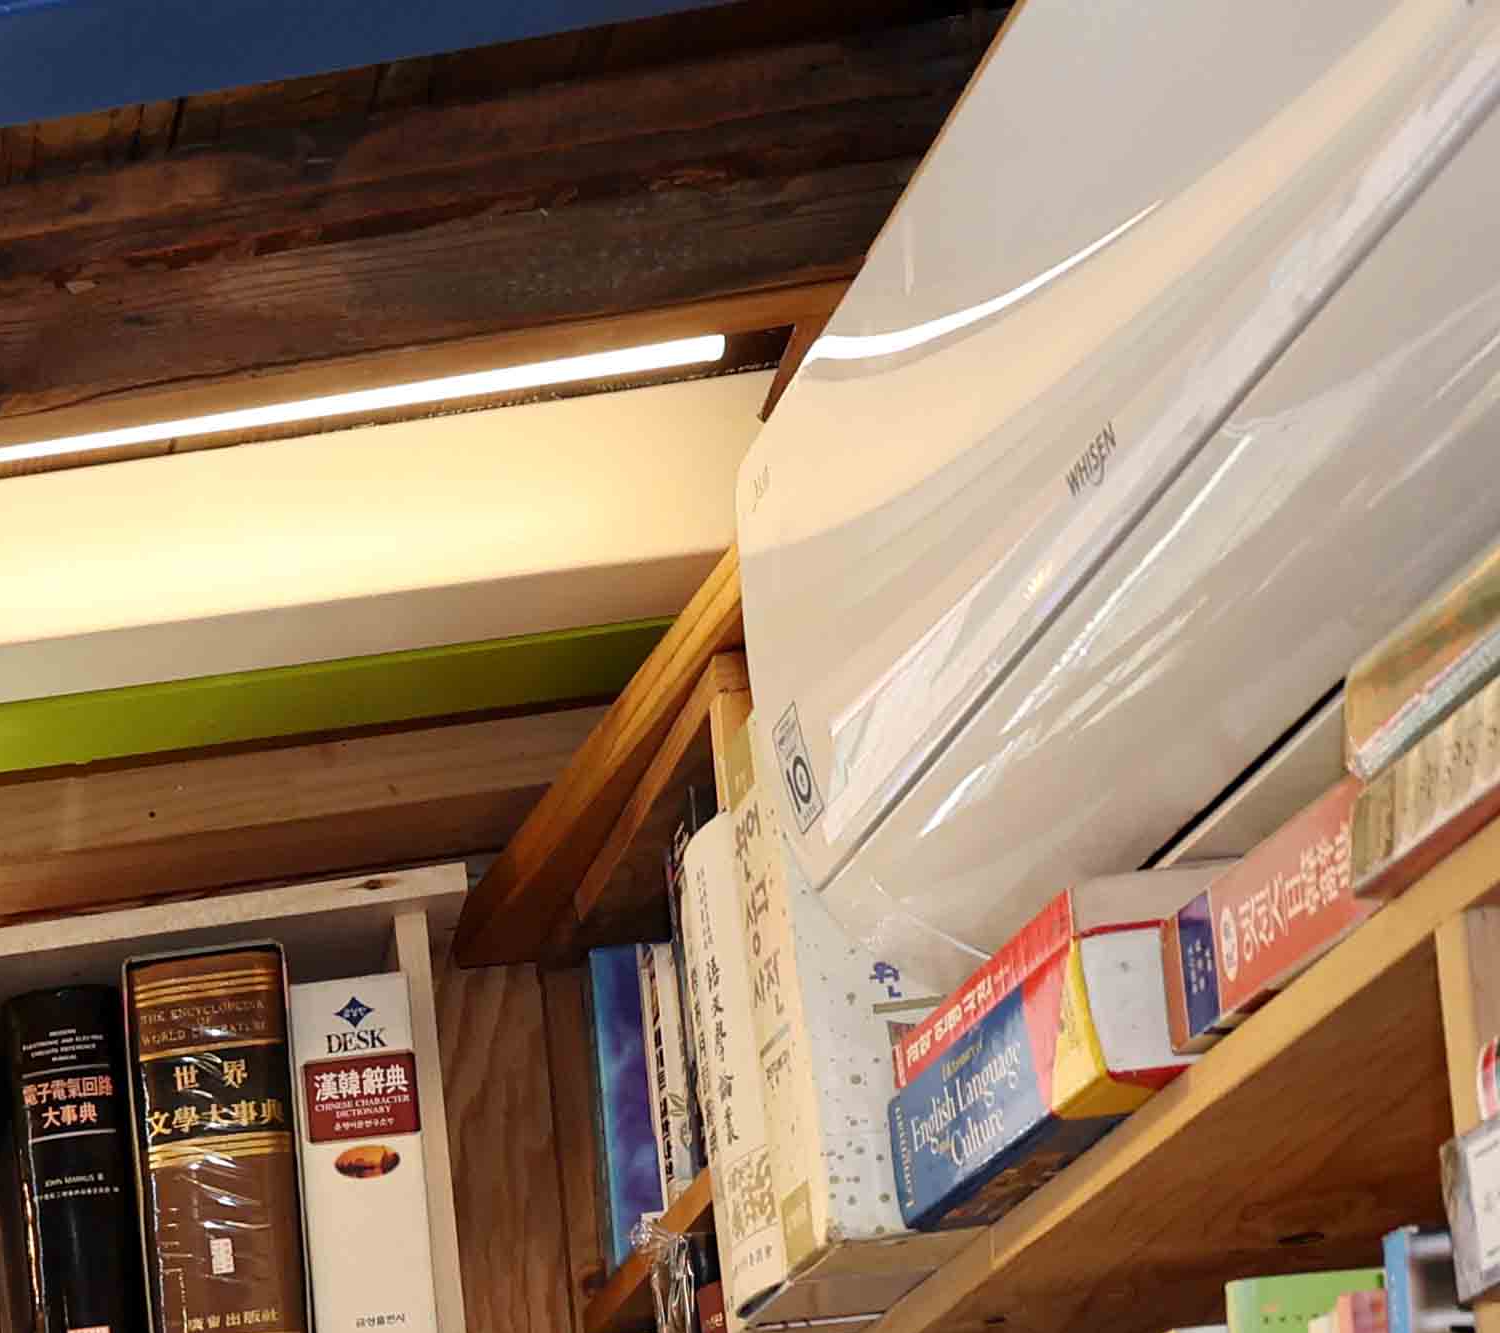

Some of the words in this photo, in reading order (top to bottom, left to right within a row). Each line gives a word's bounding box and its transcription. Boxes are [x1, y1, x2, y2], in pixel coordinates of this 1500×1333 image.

[1065, 421, 1117, 497] WHISEN
[326, 1028, 387, 1054] DESK
[314, 1064, 409, 1101] 漢韓辭典
[955, 1038, 1022, 1107] Language
[41, 1103, 99, 1129] 大事典
[315, 1101, 352, 1112] CHINESE
[354, 1094, 411, 1107] CHARACTER
[335, 1105, 392, 1119] DICTIONARY
[910, 1083, 957, 1153] English
[951, 1106, 1006, 1168] Culture
